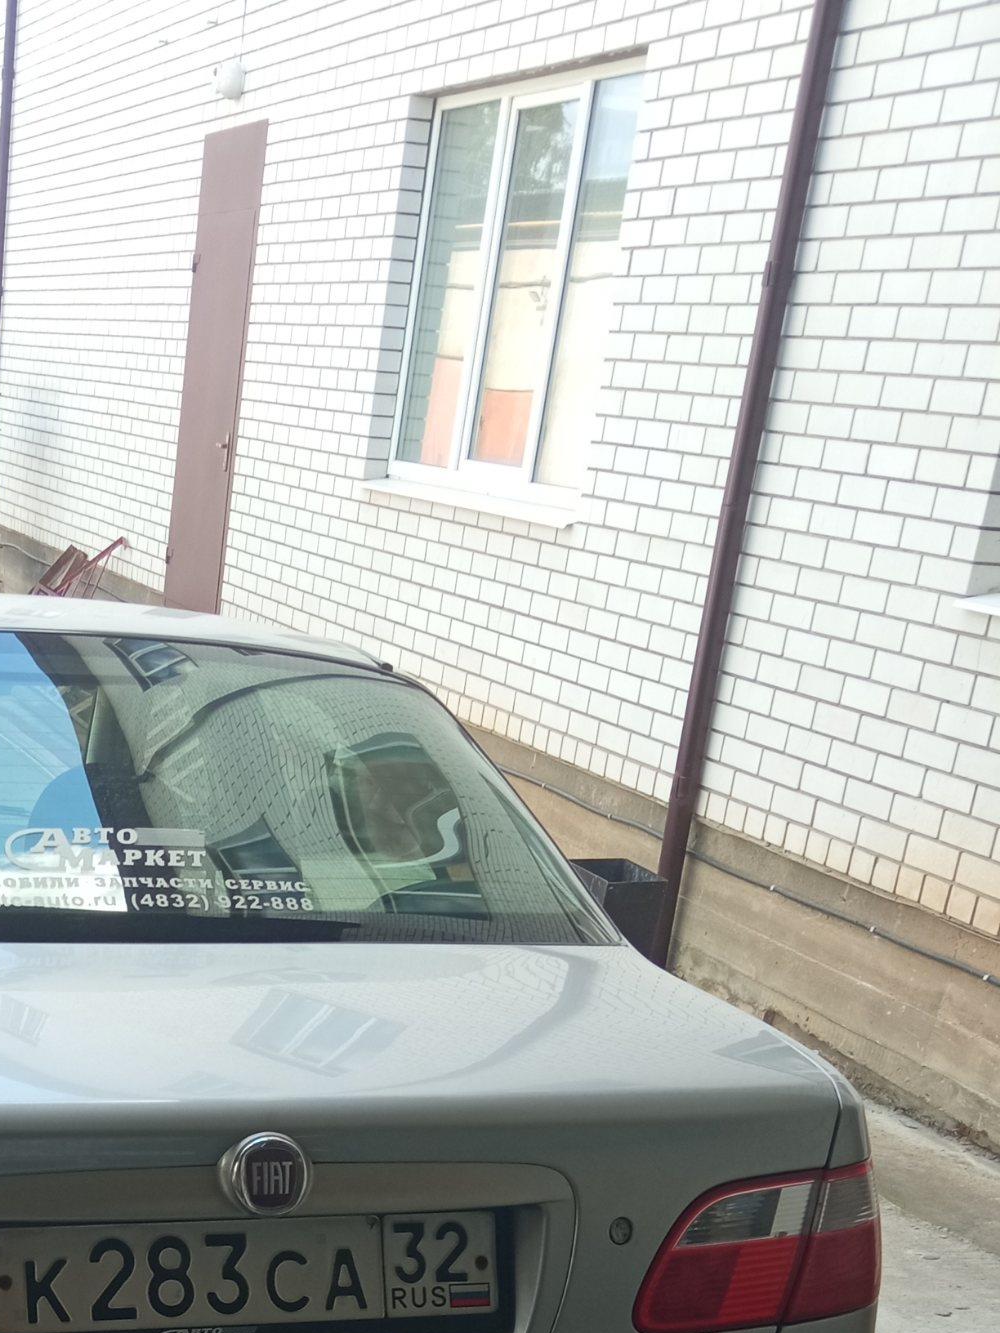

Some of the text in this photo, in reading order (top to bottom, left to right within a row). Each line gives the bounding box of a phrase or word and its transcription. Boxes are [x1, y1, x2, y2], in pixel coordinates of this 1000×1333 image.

[63, 849, 207, 874] МАРКЕТ
[94, 876, 214, 889] ЗАПЧАСТИ
[225, 879, 312, 892] СЕРВИС
[131, 893, 210, 912] (4832)
[218, 896, 315, 912] 922-888
[251, 1160, 293, 1195] FIAT
[23, 1221, 469, 1325] К283СА 32
[391, 1286, 448, 1310] RUS
